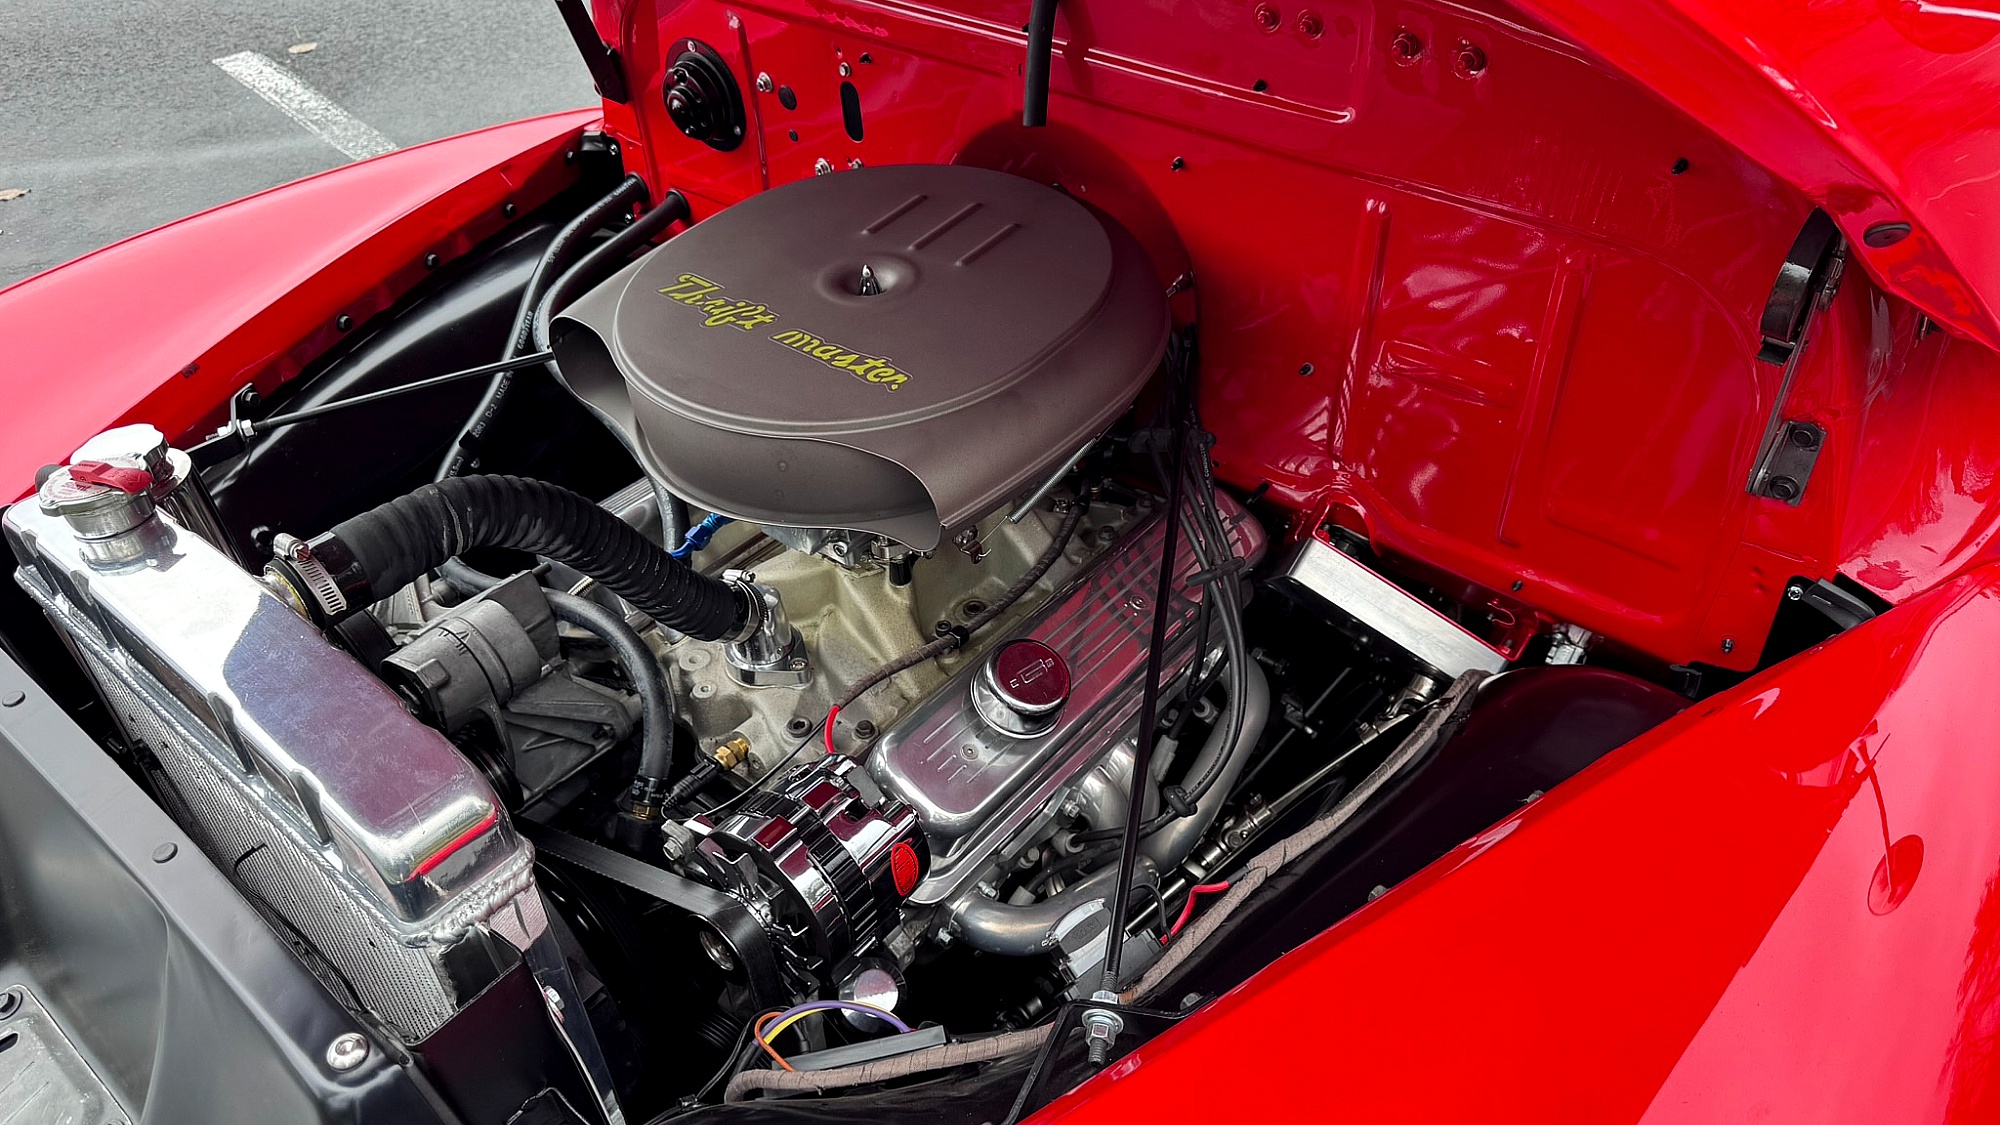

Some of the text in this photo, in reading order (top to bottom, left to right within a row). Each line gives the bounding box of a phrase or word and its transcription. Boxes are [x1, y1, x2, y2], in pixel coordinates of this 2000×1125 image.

[657, 273, 776, 330] Thrift
[517, 310, 534, 350] GOODYEAR
[496, 378, 511, 399] MADE
